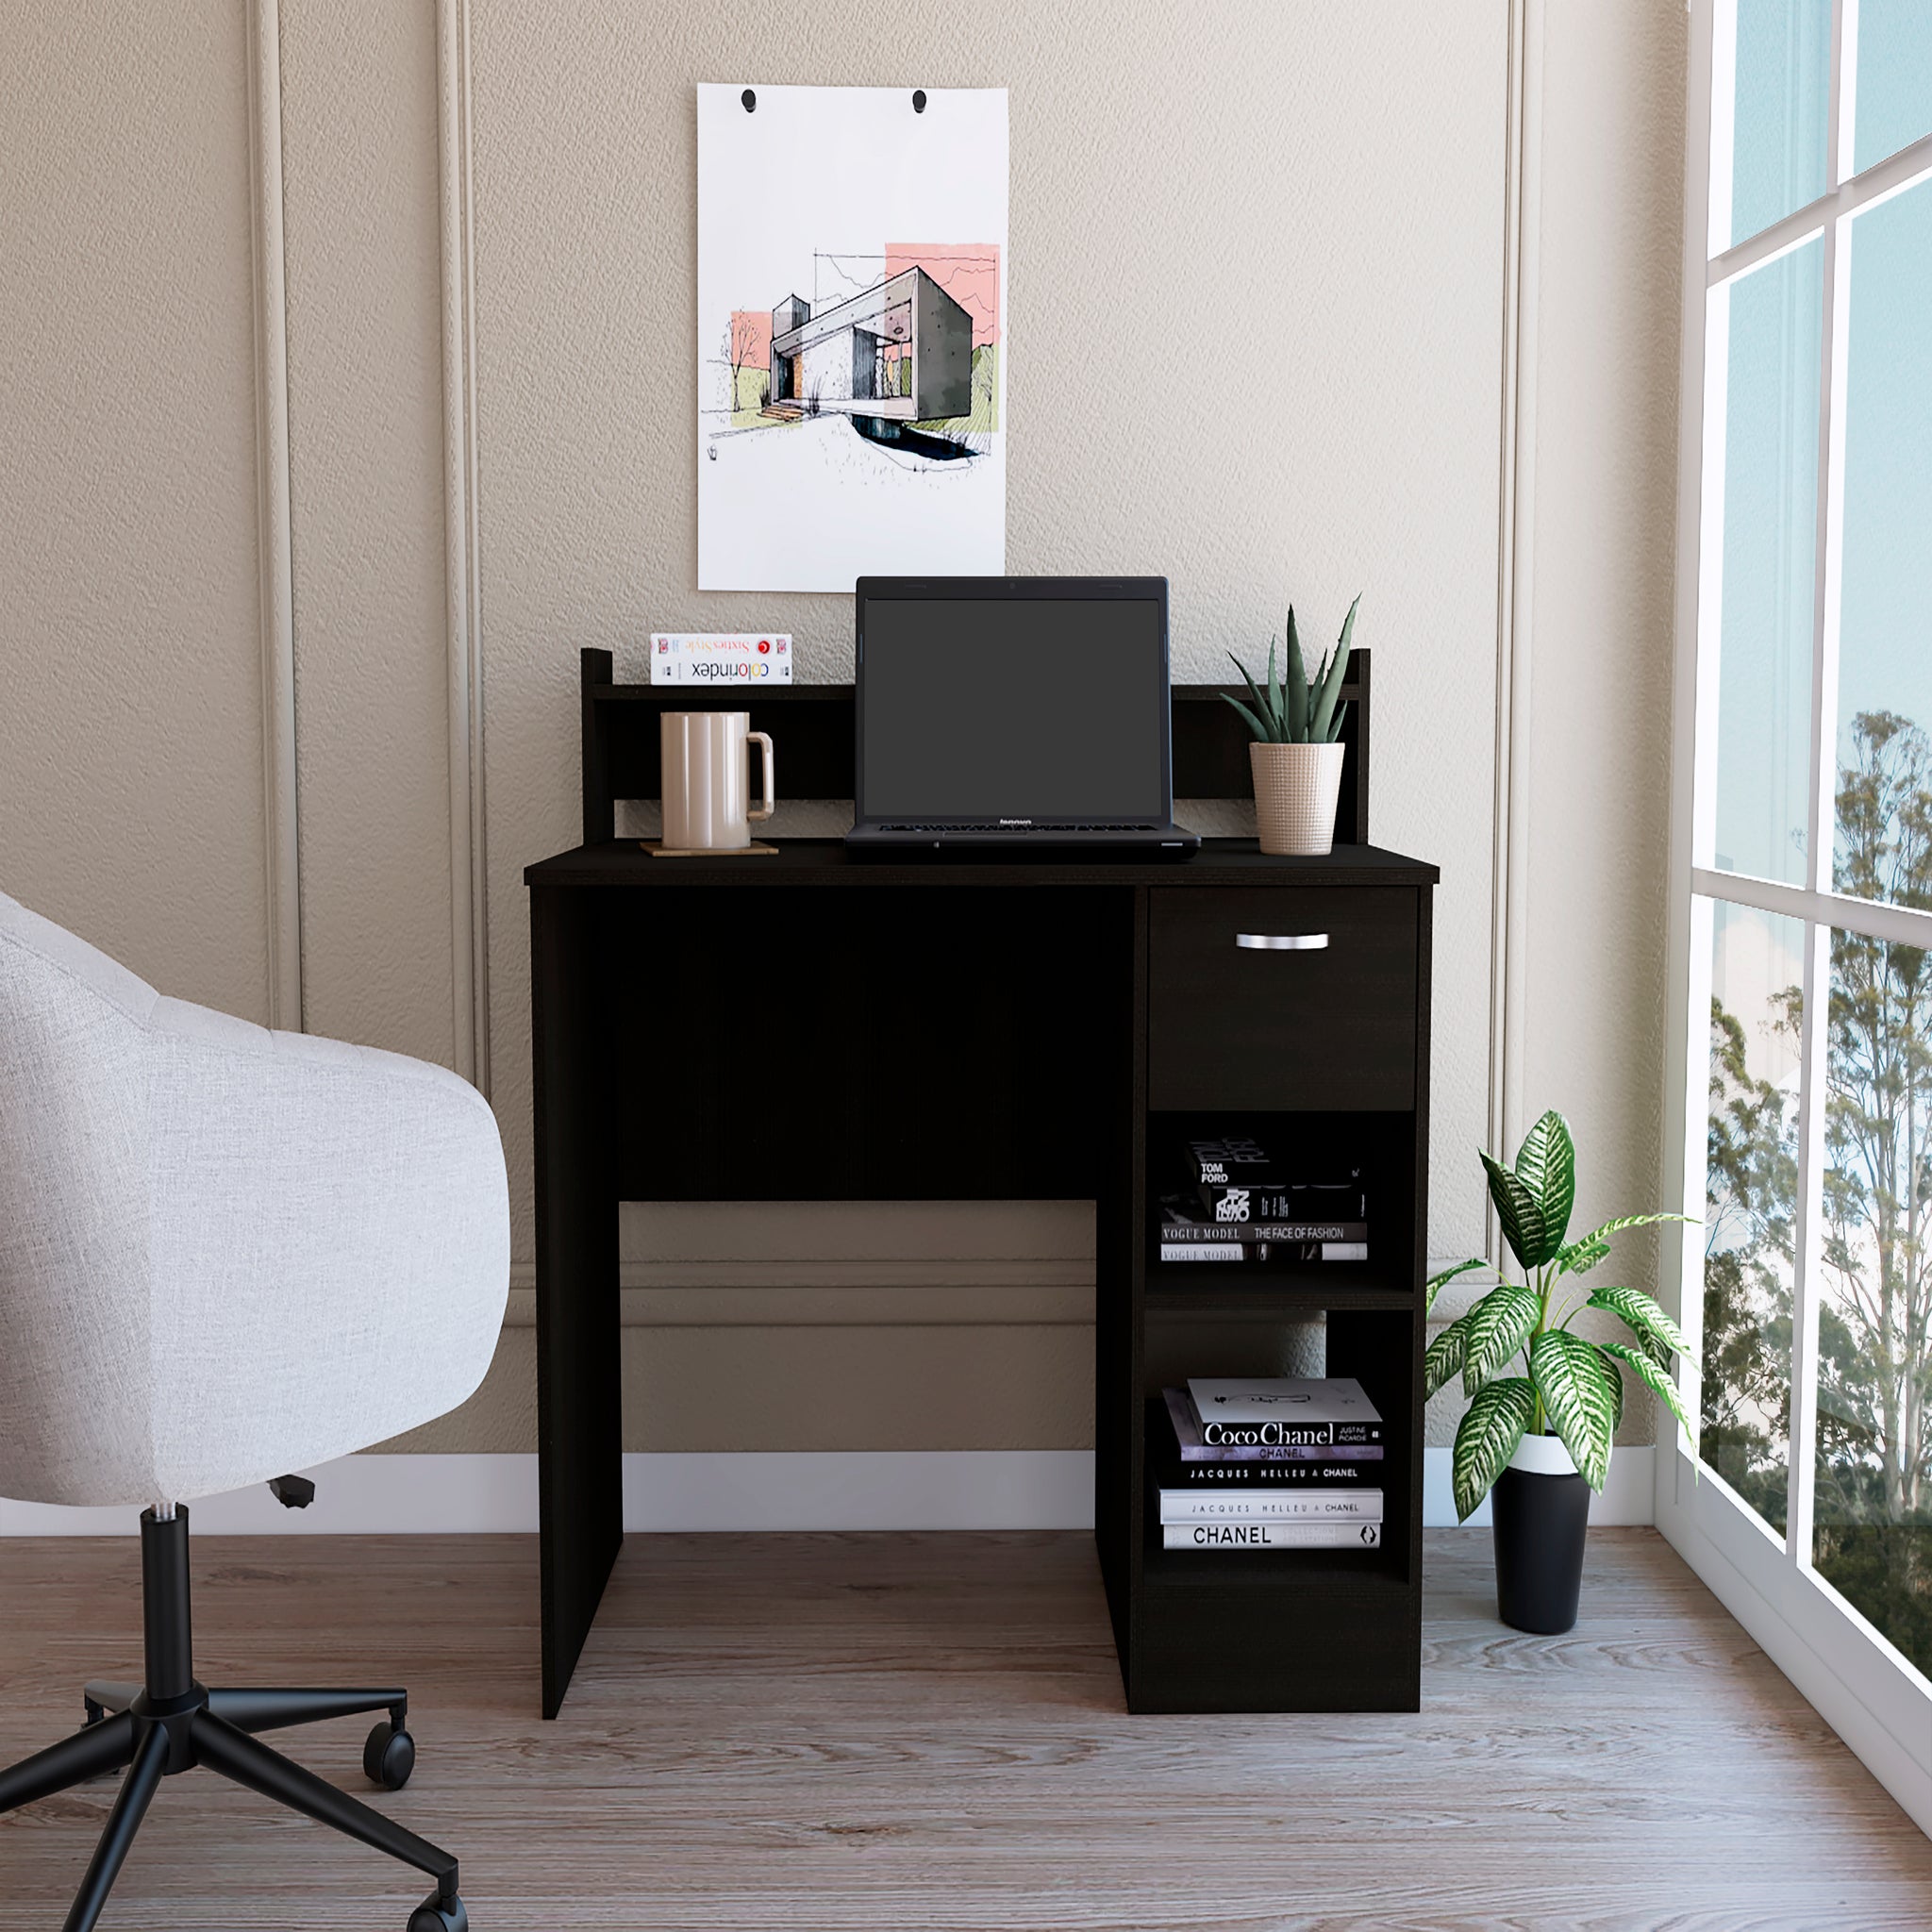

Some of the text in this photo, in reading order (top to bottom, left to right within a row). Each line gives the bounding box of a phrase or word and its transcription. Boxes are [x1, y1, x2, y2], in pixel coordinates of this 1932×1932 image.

[686, 638, 712, 653] Style
[713, 641, 750, 654] Sixties
[691, 662, 769, 681] colorindex
[1201, 1163, 1223, 1174] TOM
[1201, 1174, 1228, 1183] FORD
[1163, 1227, 1343, 1240] VOGUE MODEL THE FACE OF FASHION
[1163, 1249, 1240, 1260] VOGUE MODEL
[1205, 1423, 1334, 1445] Coco Chanel
[1259, 1448, 1306, 1458] CHANEL
[1191, 1469, 1249, 1478] JACQUES
[1260, 1469, 1306, 1478] HELLEU
[1323, 1468, 1357, 1477] CHANEL
[1192, 1505, 1250, 1513] JACQUES
[1262, 1505, 1307, 1513] HELLEU
[1324, 1504, 1359, 1512] CHANEL
[1193, 1526, 1272, 1543] CHANEL
